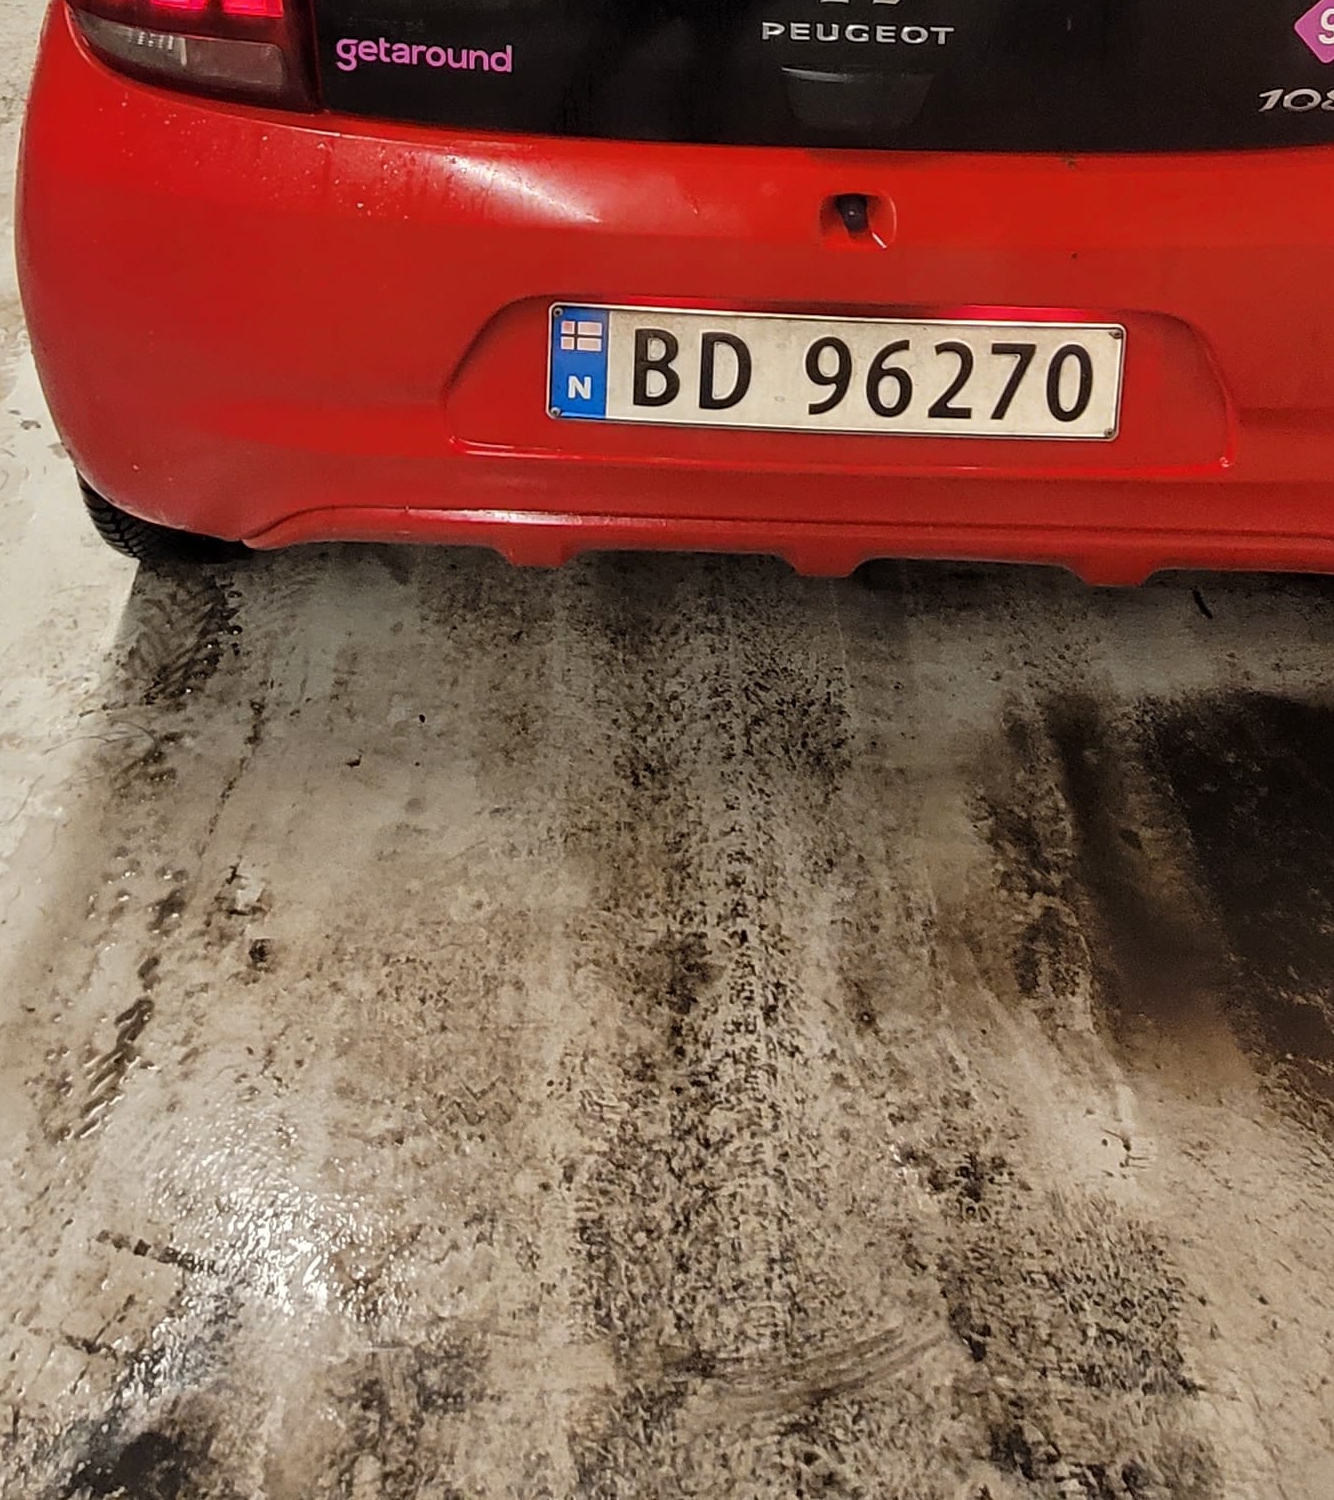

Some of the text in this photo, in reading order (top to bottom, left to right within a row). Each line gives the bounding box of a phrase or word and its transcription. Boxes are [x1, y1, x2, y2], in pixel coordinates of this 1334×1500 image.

[761, 21, 955, 45] PEUGEOT
[335, 36, 513, 73] getaround
[567, 374, 593, 400] N
[632, 327, 1094, 423] BD 96270
